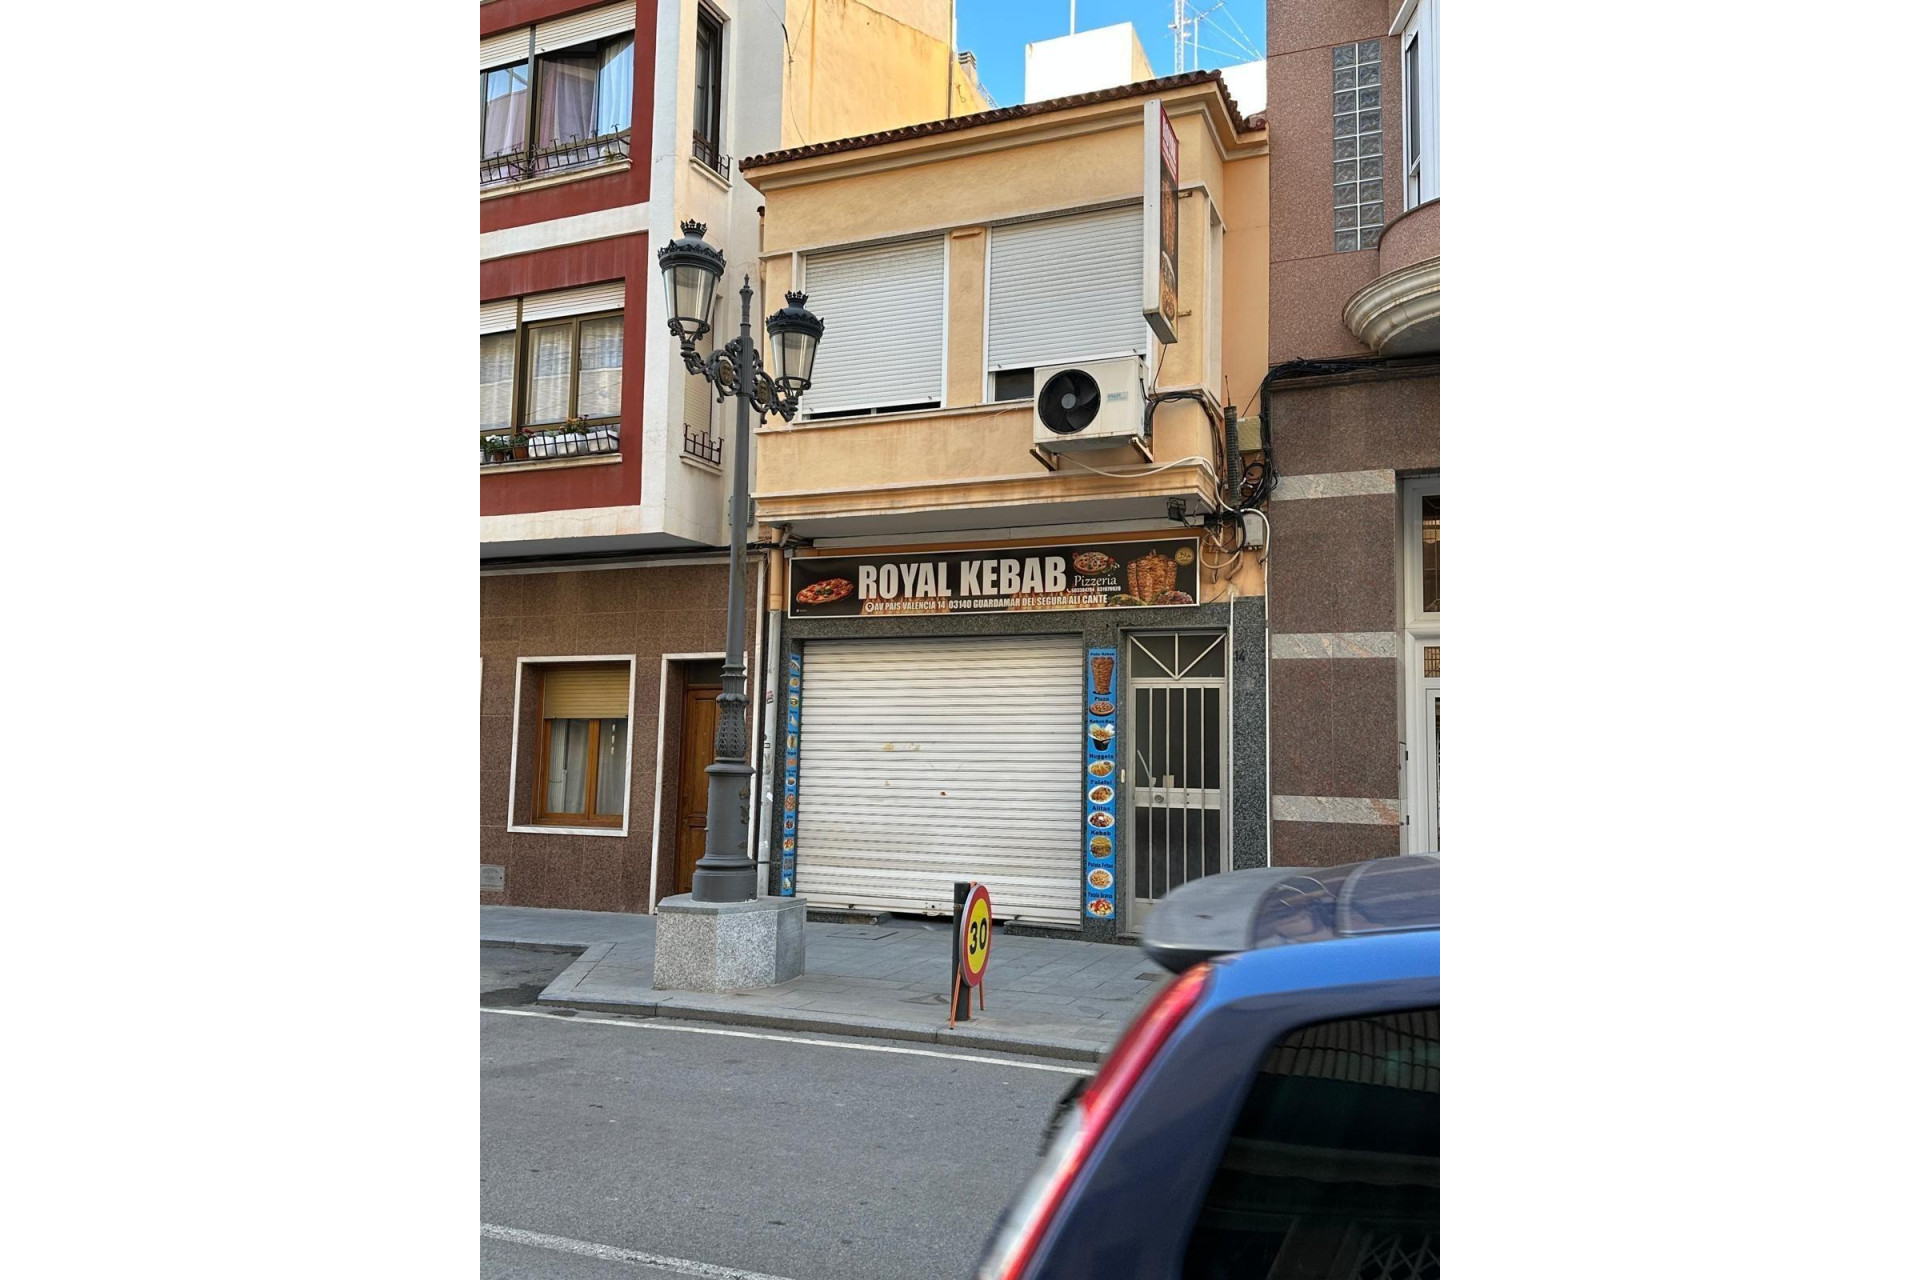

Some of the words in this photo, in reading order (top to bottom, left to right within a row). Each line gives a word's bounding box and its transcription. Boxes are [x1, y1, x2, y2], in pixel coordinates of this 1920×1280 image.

[858, 562, 952, 600] ROYAL
[960, 556, 1067, 597] KEBAB
[1074, 574, 1117, 586] Pizzeria
[874, 602, 884, 611] AV
[902, 601, 936, 610] VALENCIA
[938, 600, 946, 609] 14
[948, 599, 972, 609] 03140
[973, 598, 1020, 608] GUARDAMAR
[1022, 597, 1035, 606] DEL
[1037, 596, 1067, 606] SEGURA
[1235, 650, 1245, 661] 14
[969, 917, 987, 954] 30
